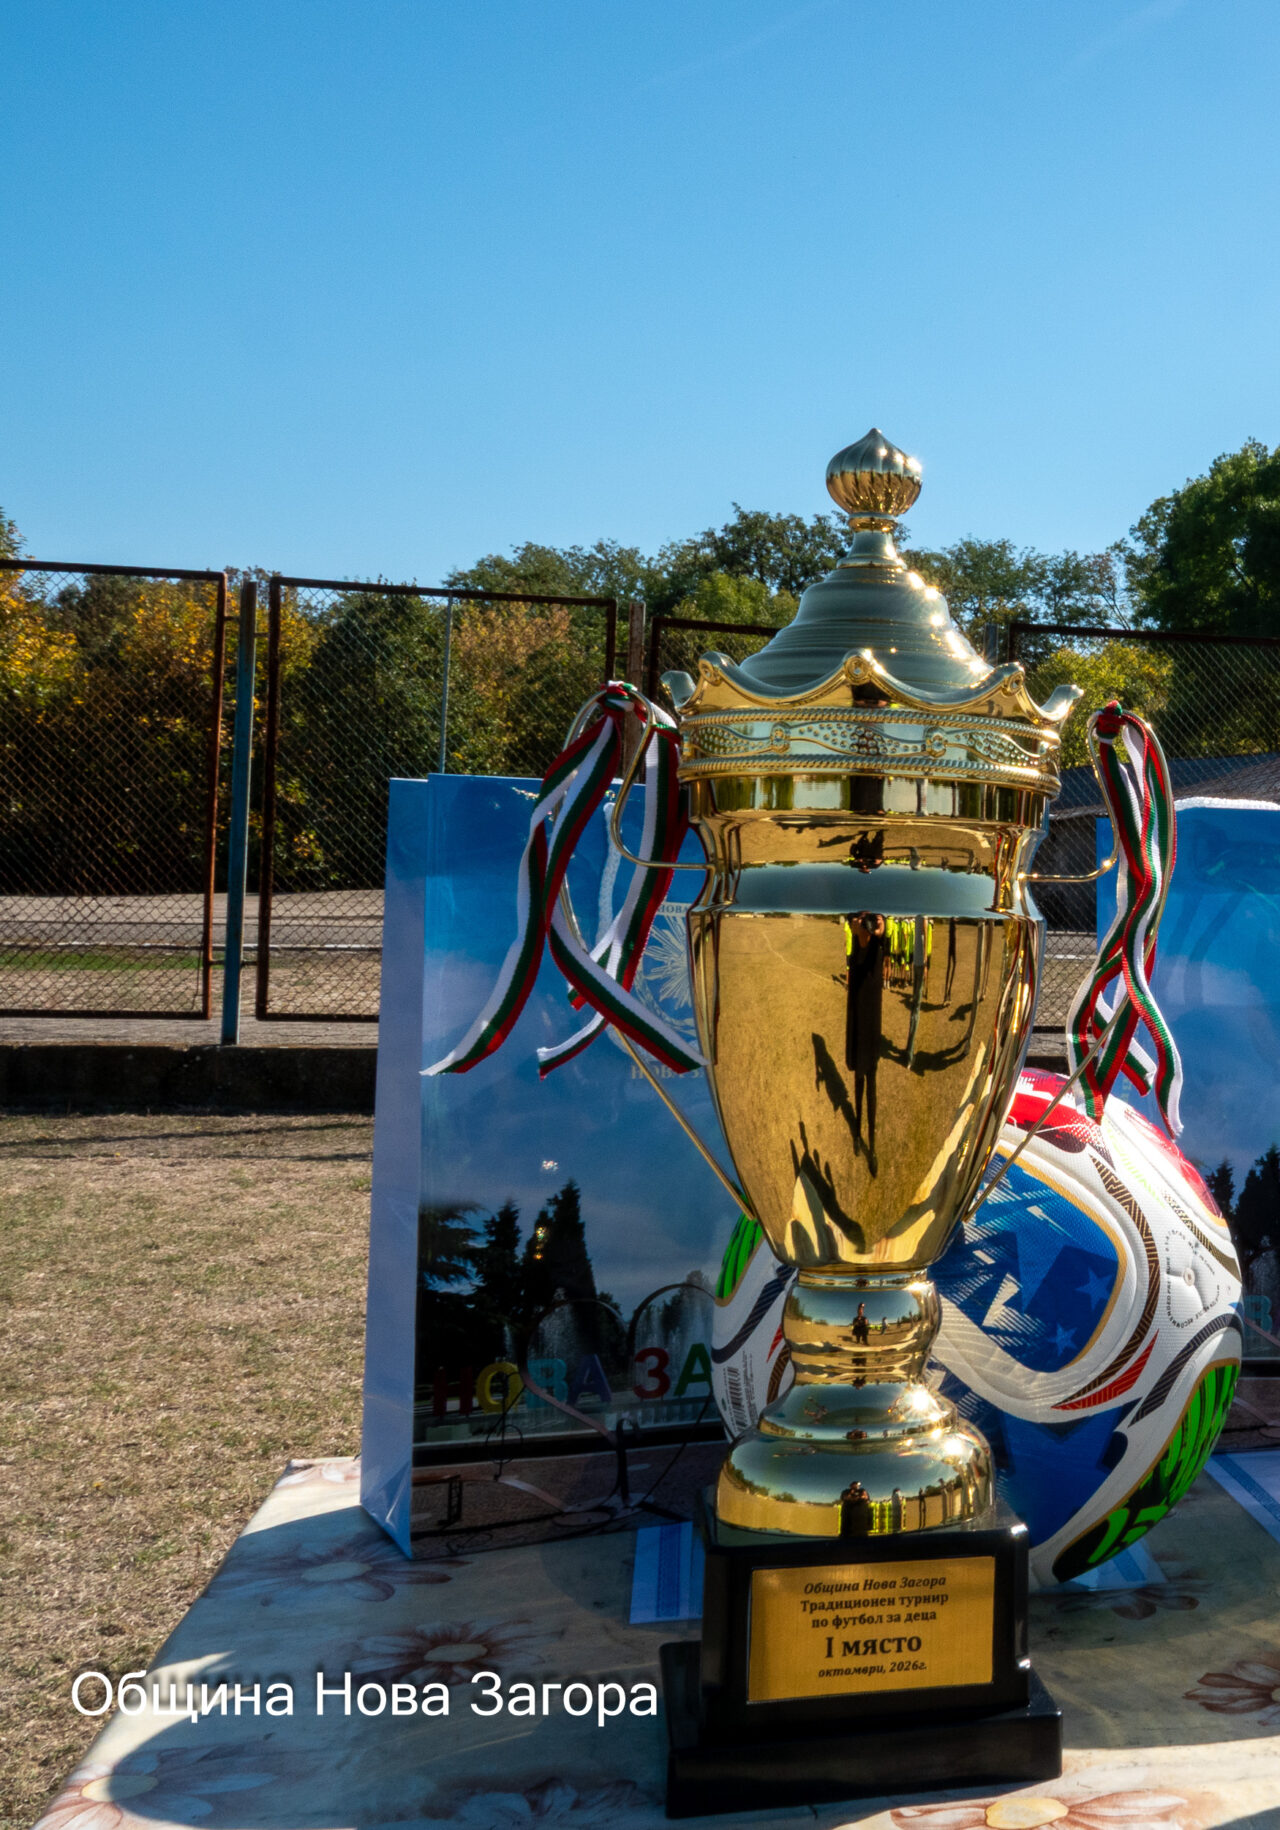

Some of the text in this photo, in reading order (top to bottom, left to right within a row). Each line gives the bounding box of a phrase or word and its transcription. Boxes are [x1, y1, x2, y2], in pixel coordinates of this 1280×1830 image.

[432, 1354, 613, 1417] НОВА
[804, 1575, 947, 1596] Община Нова Загора
[800, 1592, 949, 1614] Традиционен турнир
[812, 1610, 937, 1630] по футбол за деца
[825, 1636, 834, 1659] I
[818, 1660, 928, 1679] октомври, 2026г.
